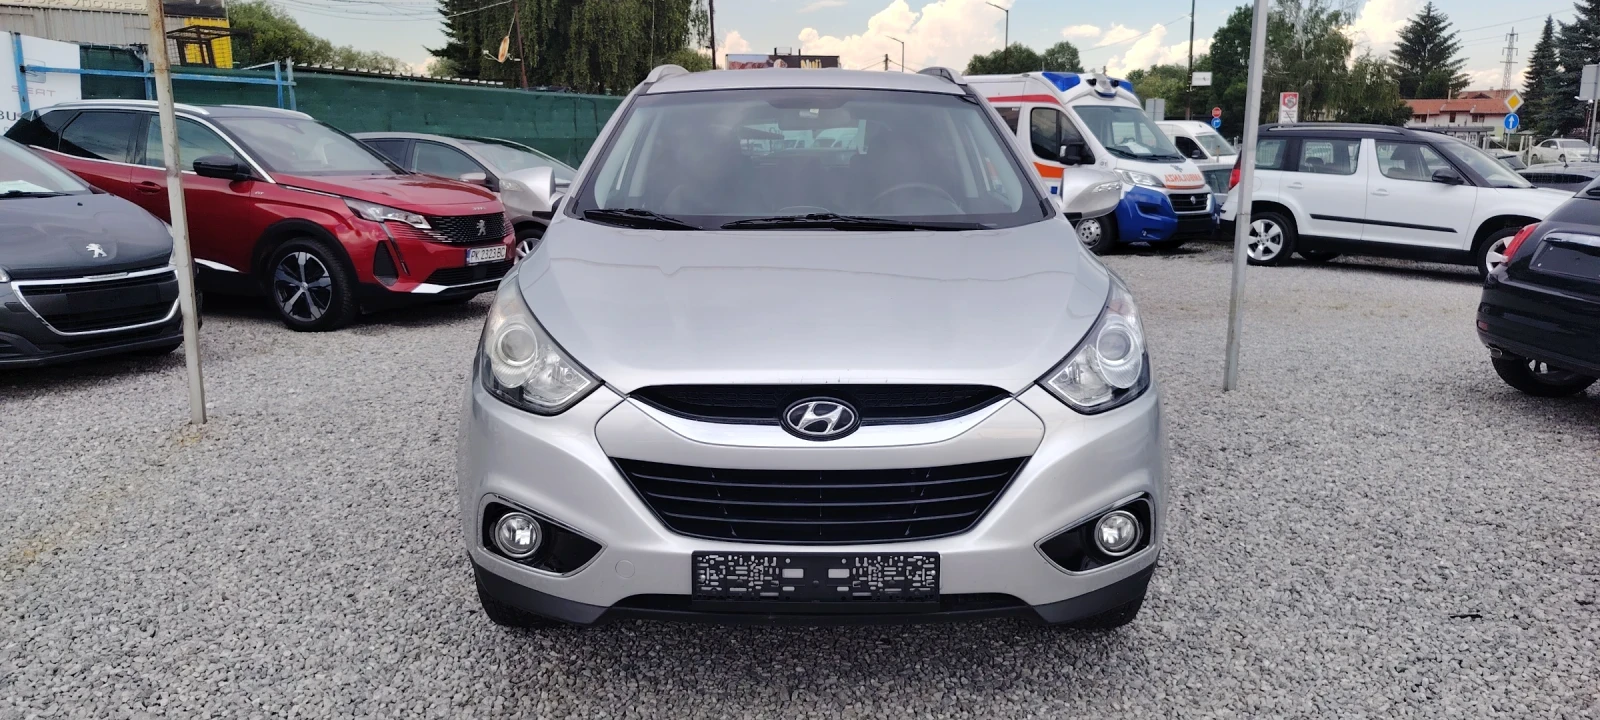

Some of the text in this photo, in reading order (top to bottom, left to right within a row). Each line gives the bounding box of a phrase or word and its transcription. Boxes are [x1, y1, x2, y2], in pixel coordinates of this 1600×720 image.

[11, 85, 56, 96] SEAT
[471, 250, 480, 261] PK
[480, 249, 496, 260] 2323
